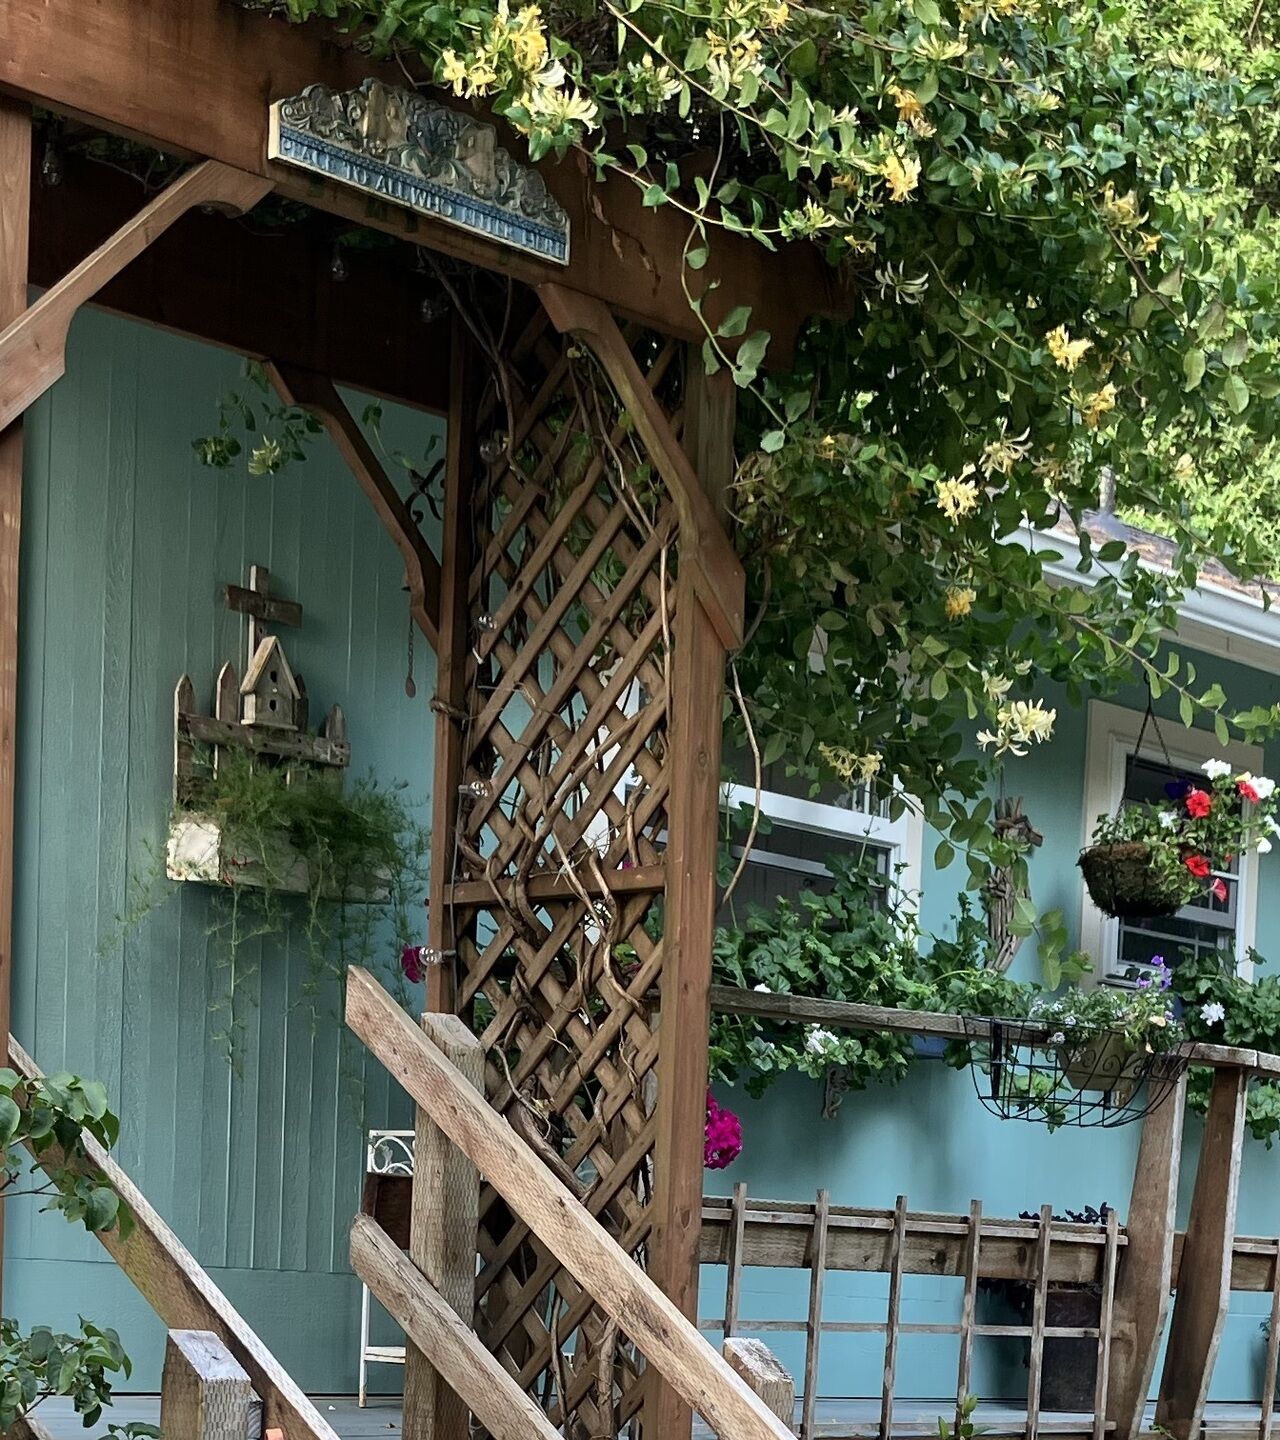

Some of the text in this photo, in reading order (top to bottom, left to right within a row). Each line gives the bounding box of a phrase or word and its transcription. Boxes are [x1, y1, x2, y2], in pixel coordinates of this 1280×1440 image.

[342, 160, 368, 184] TO
[375, 174, 409, 201] ALL
[410, 186, 452, 216] WHO
